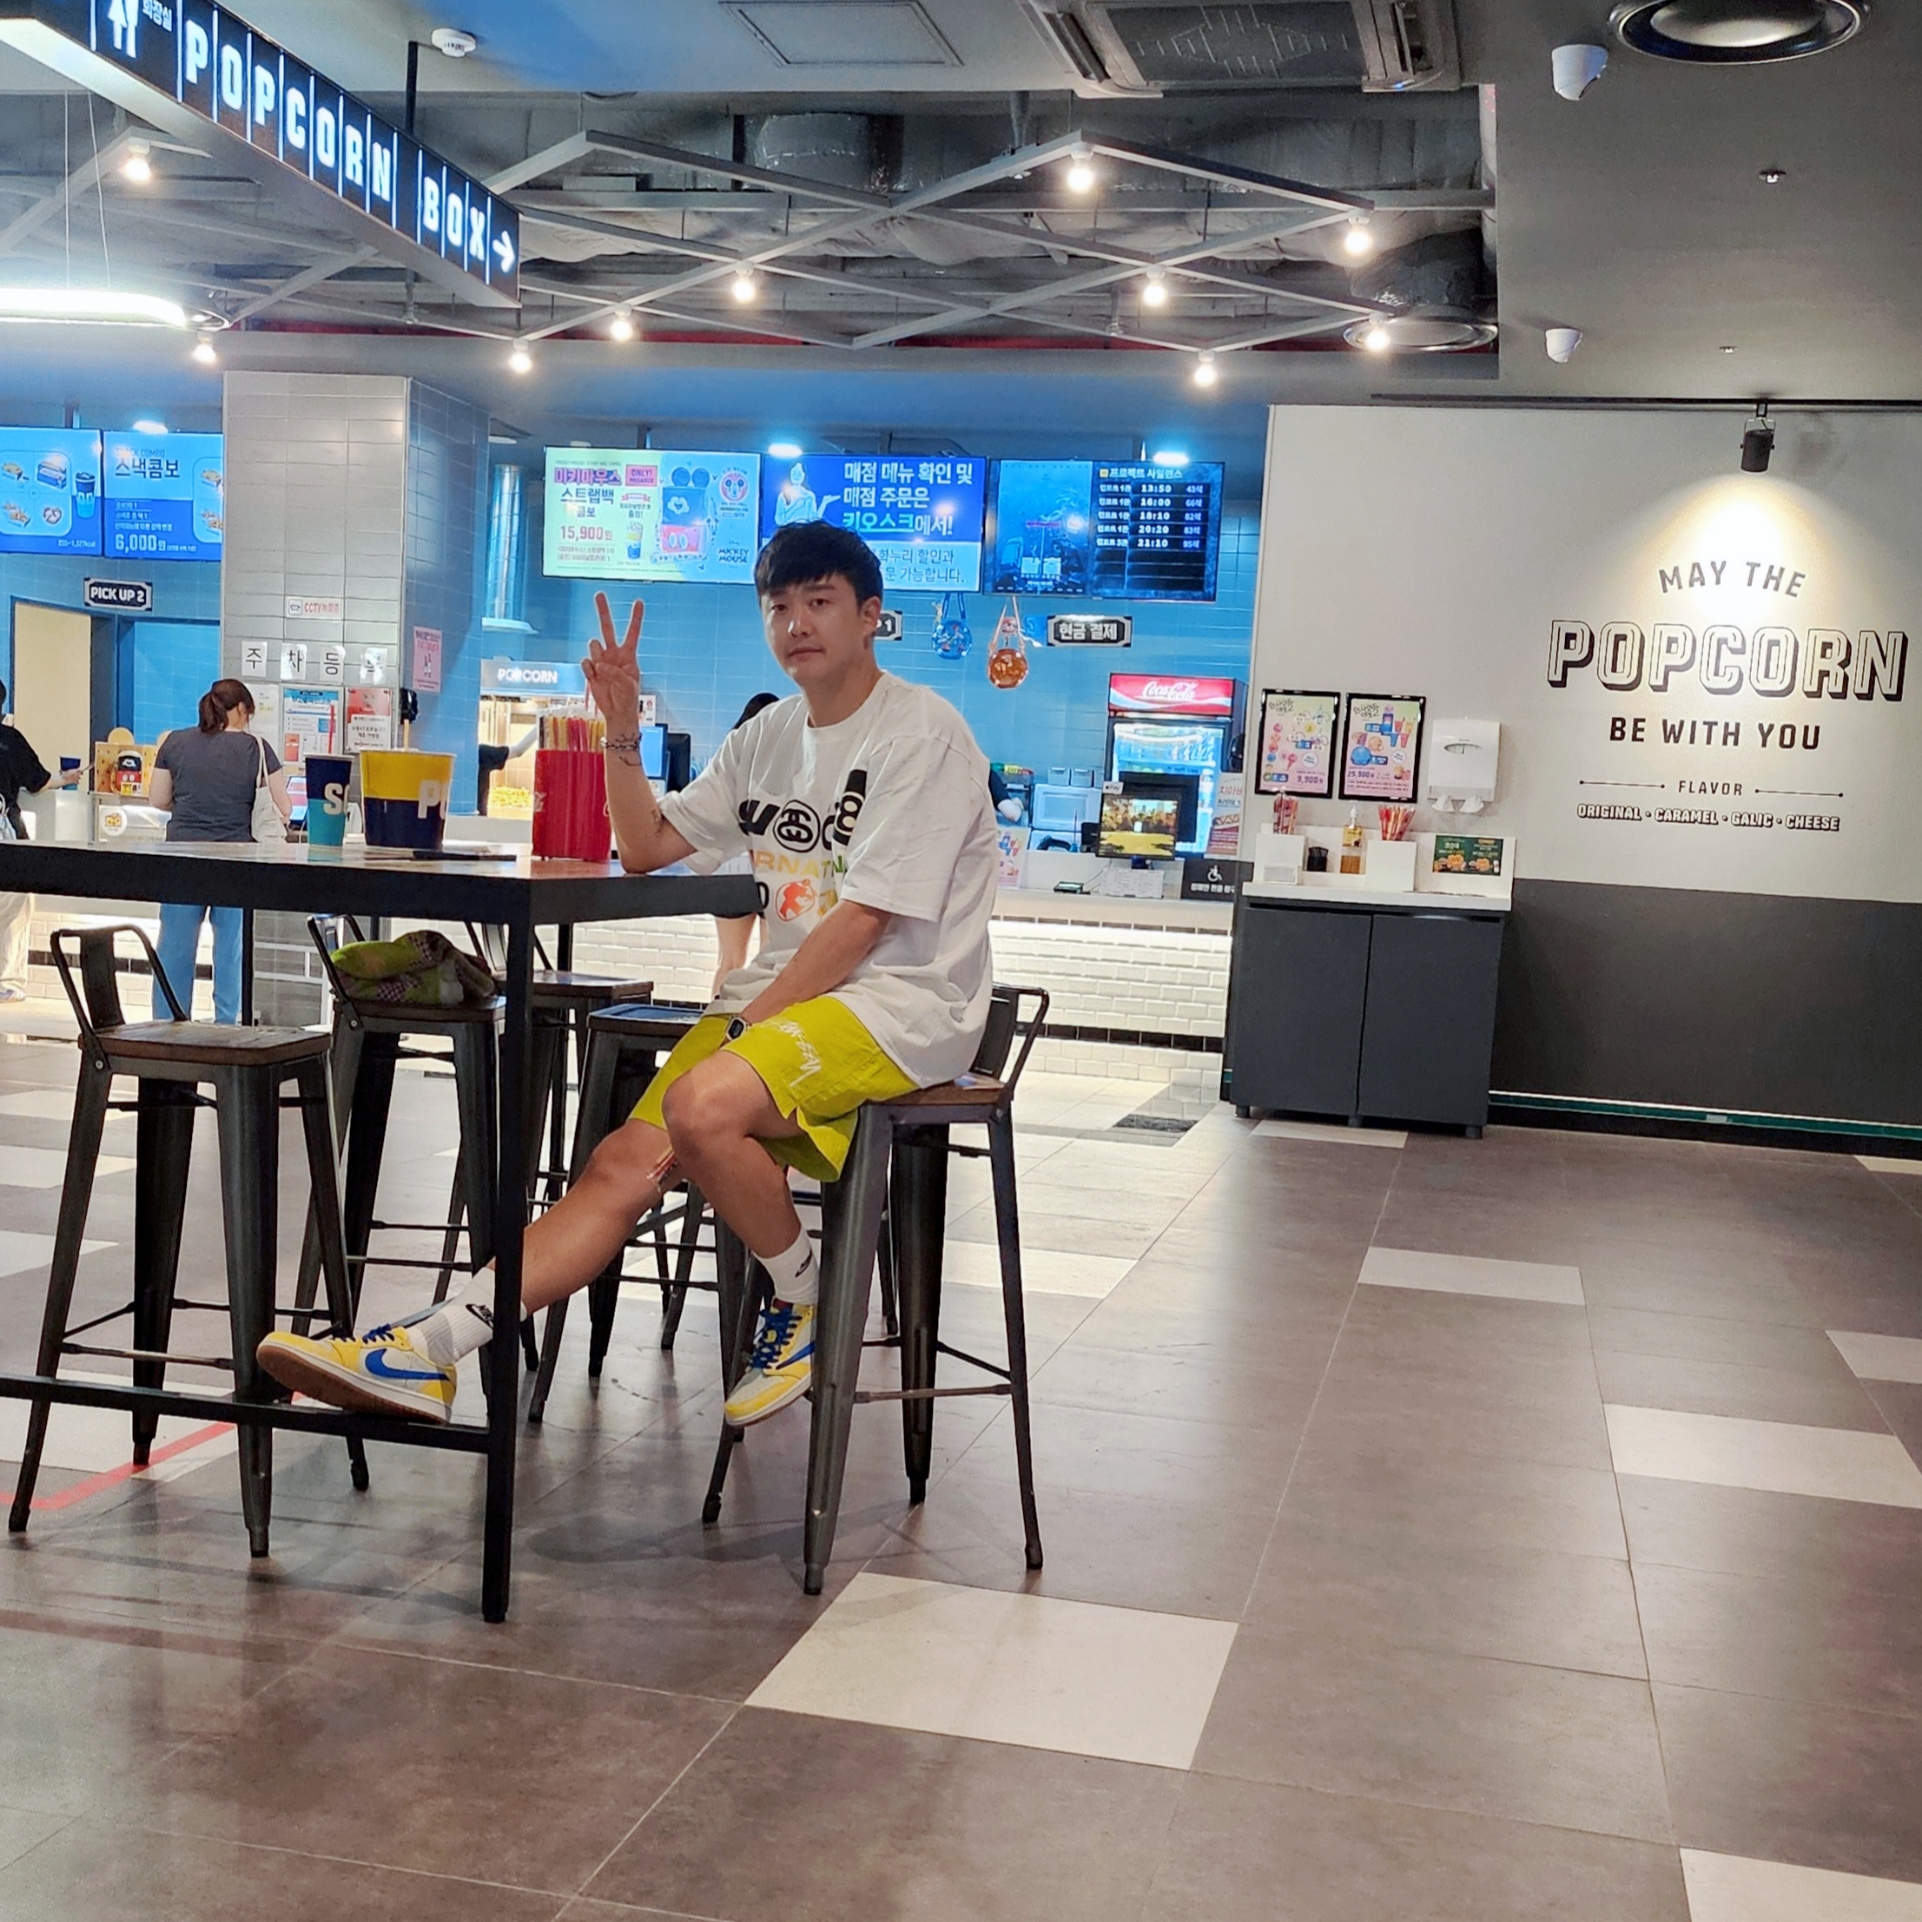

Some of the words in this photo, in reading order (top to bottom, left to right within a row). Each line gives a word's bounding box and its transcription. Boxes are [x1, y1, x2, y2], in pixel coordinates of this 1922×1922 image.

[185, 19, 392, 202] POPCORN
[423, 176, 486, 262] BOX
[115, 458, 180, 479] 스낵콤보
[554, 467, 622, 487] 미키마우스
[844, 462, 877, 484] 매점
[881, 462, 915, 484] 메뉴
[918, 462, 951, 485] 확인
[956, 463, 973, 485] 및
[1109, 467, 1145, 479] 프로젝트
[1147, 468, 1183, 479] 사일런스
[560, 487, 614, 505] 스트랩백
[843, 486, 876, 508] 매점
[880, 487, 930, 509] 주문은
[842, 511, 953, 536] 키오스크에서!
[873, 547, 914, 564] 화누리
[917, 548, 955, 565] 할인과
[900, 567, 965, 583] 가능합니다.
[1658, 560, 1728, 594] MAY
[1744, 560, 1807, 599] THE
[90, 586, 117, 600] PICK
[119, 588, 135, 602] UP
[137, 590, 145, 602] 2
[884, 618, 893, 632] 1
[1058, 622, 1087, 641] 현금
[1090, 622, 1118, 641] 결제
[245, 647, 263, 670] 주
[323, 651, 341, 677] 등
[1546, 618, 1910, 703] POPCORN
[497, 668, 559, 684] POPCORN
[1609, 716, 1647, 743] BE
[1661, 719, 1741, 748] WITH
[1757, 722, 1822, 751] YOU
[1677, 780, 1744, 797] FLAVOR
[1576, 803, 1643, 822] ORIGINAL
[1653, 807, 1720, 826] CARAMEL
[1730, 811, 1774, 829] GALIC
[1784, 814, 1841, 833] CHEESE
